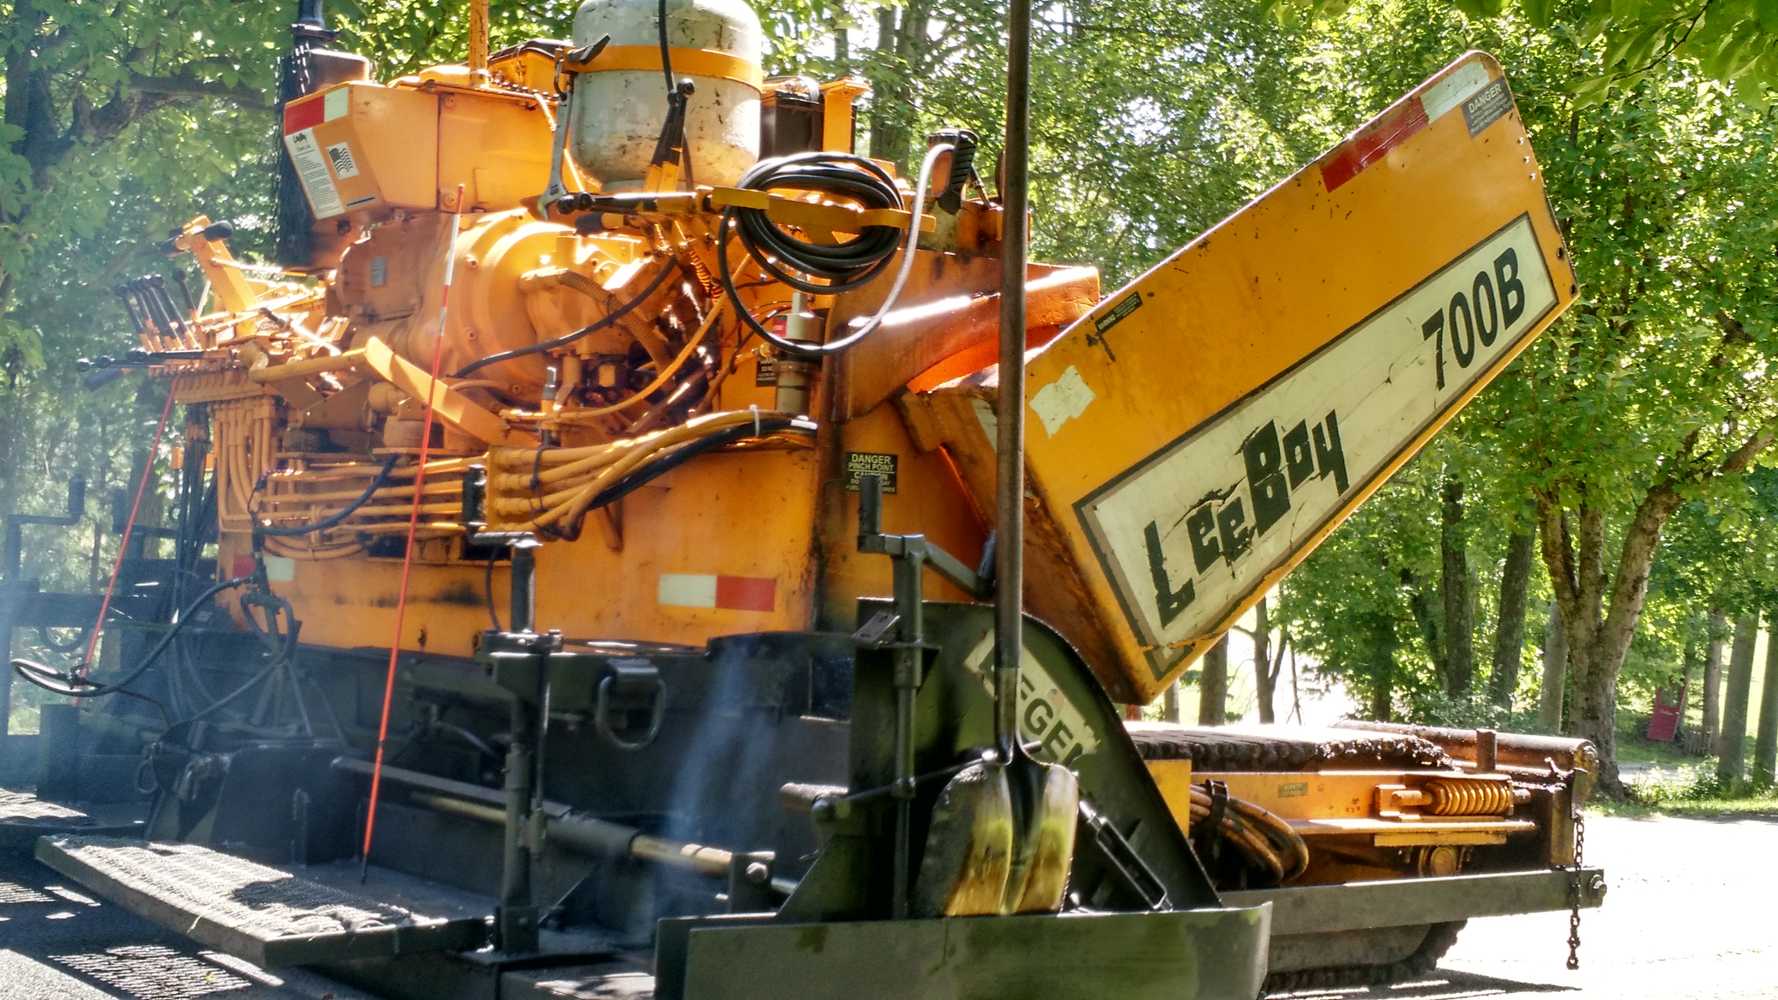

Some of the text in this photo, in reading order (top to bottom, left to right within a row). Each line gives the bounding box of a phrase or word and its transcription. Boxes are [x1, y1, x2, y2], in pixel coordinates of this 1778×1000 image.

[1468, 83, 1502, 113] DANGER
[1421, 247, 1525, 391] 700B
[848, 462, 894, 472] PINCH POINT
[851, 454, 891, 464] DANGER
[1144, 409, 1350, 630] LeeBoy
